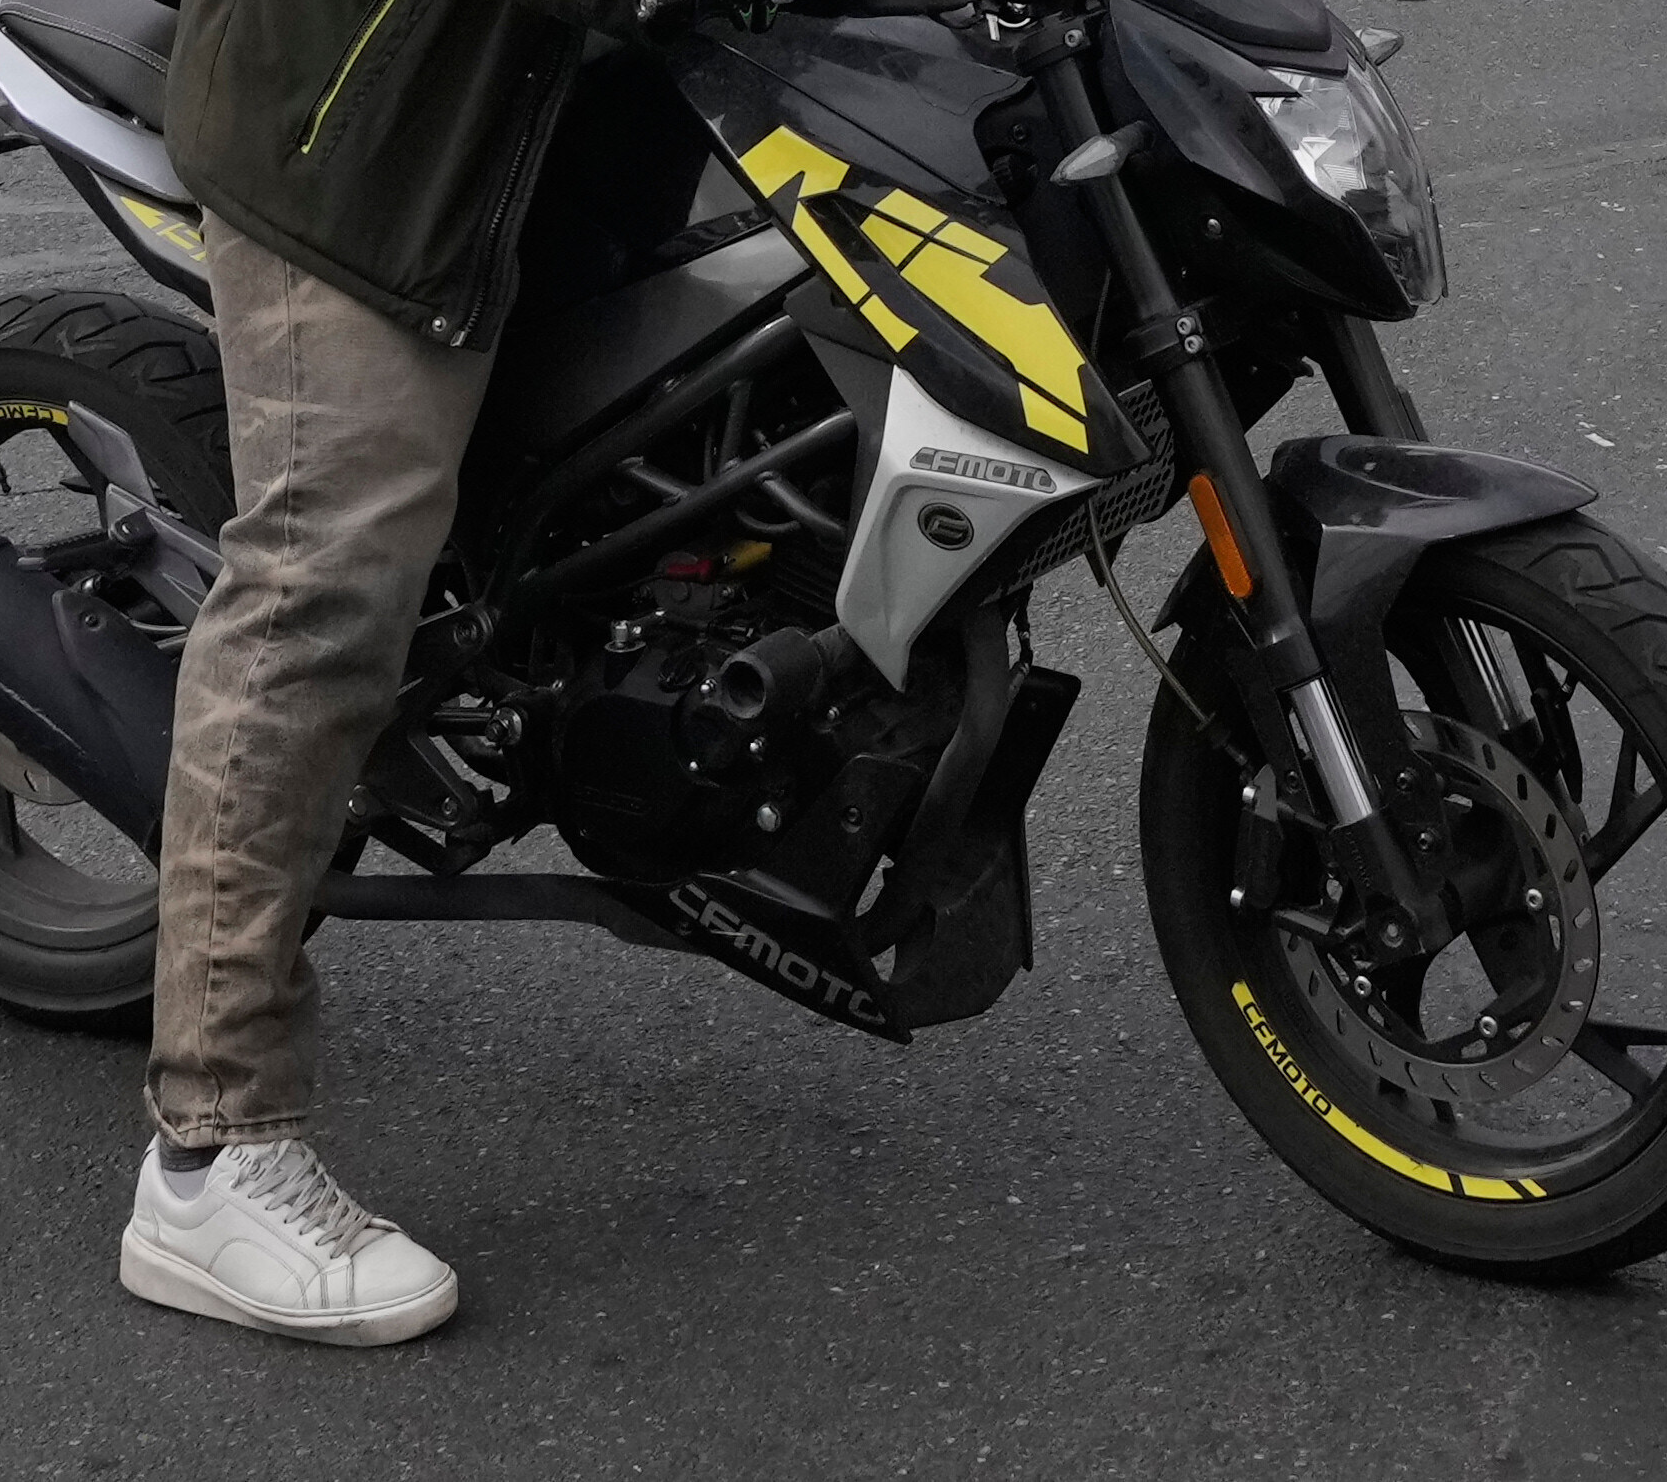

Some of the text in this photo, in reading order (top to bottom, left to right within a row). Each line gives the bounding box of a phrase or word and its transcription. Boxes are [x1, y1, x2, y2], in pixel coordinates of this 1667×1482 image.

[909, 447, 1058, 494] CFMOTO
[668, 882, 887, 1025] CFMOTO
[1242, 1001, 1332, 1116] CFMOTO
